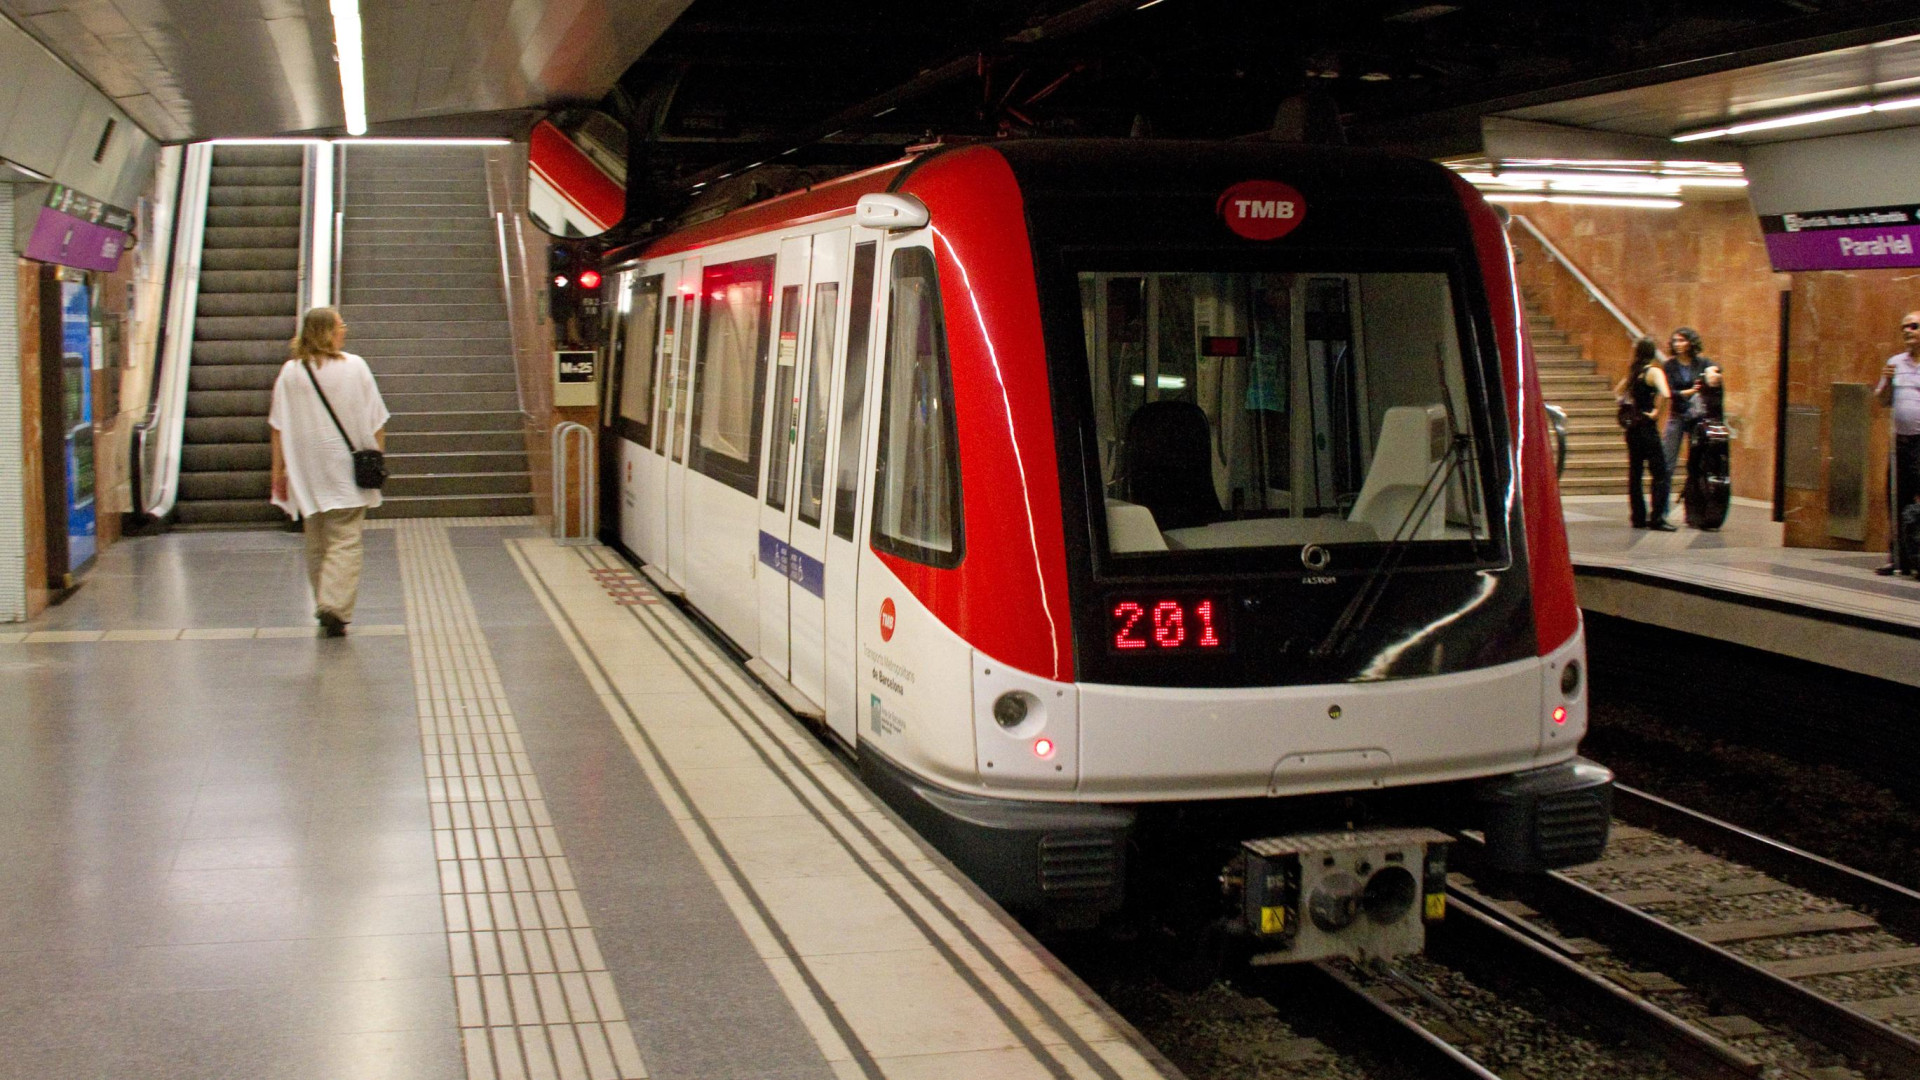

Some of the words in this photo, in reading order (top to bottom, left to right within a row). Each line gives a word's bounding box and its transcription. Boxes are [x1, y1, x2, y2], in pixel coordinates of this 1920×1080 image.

[1235, 200, 1295, 219] TMB
[881, 612, 895, 630] TMB
[1114, 601, 1219, 648] 201
[879, 670, 904, 696] Barcelona
